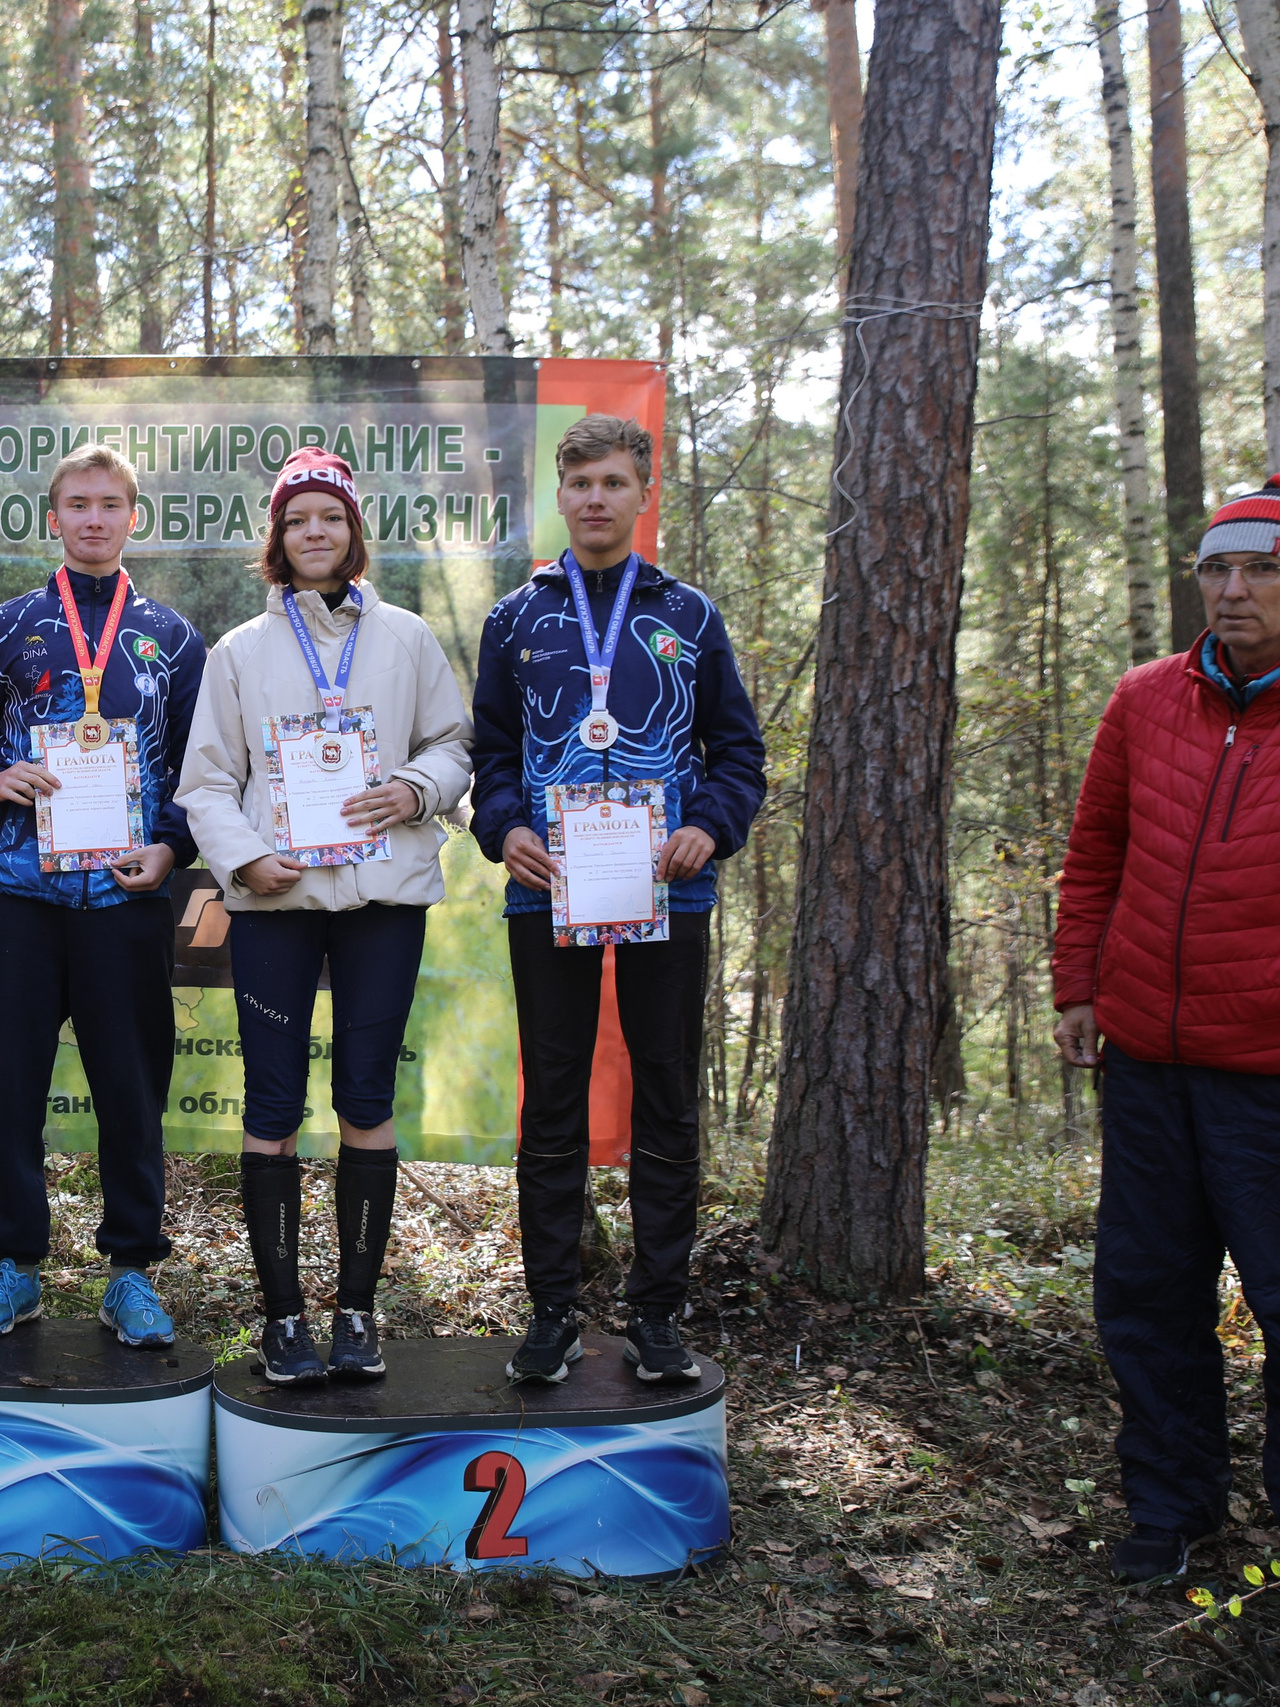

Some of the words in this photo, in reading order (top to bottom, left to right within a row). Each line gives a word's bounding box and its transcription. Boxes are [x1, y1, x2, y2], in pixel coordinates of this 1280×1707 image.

[286, 467, 361, 508] adid
[571, 569, 584, 600] ОБЛАСТЬ
[577, 601, 595, 654] ЧЕЛЯБИНСКАЯ
[605, 620, 619, 654] ОБЛАСТЬ
[23, 648, 48, 660] DINA
[56, 754, 116, 766] ГРАМОТА
[573, 819, 640, 832] ГРАМОТА
[463, 1450, 528, 1560] 2
